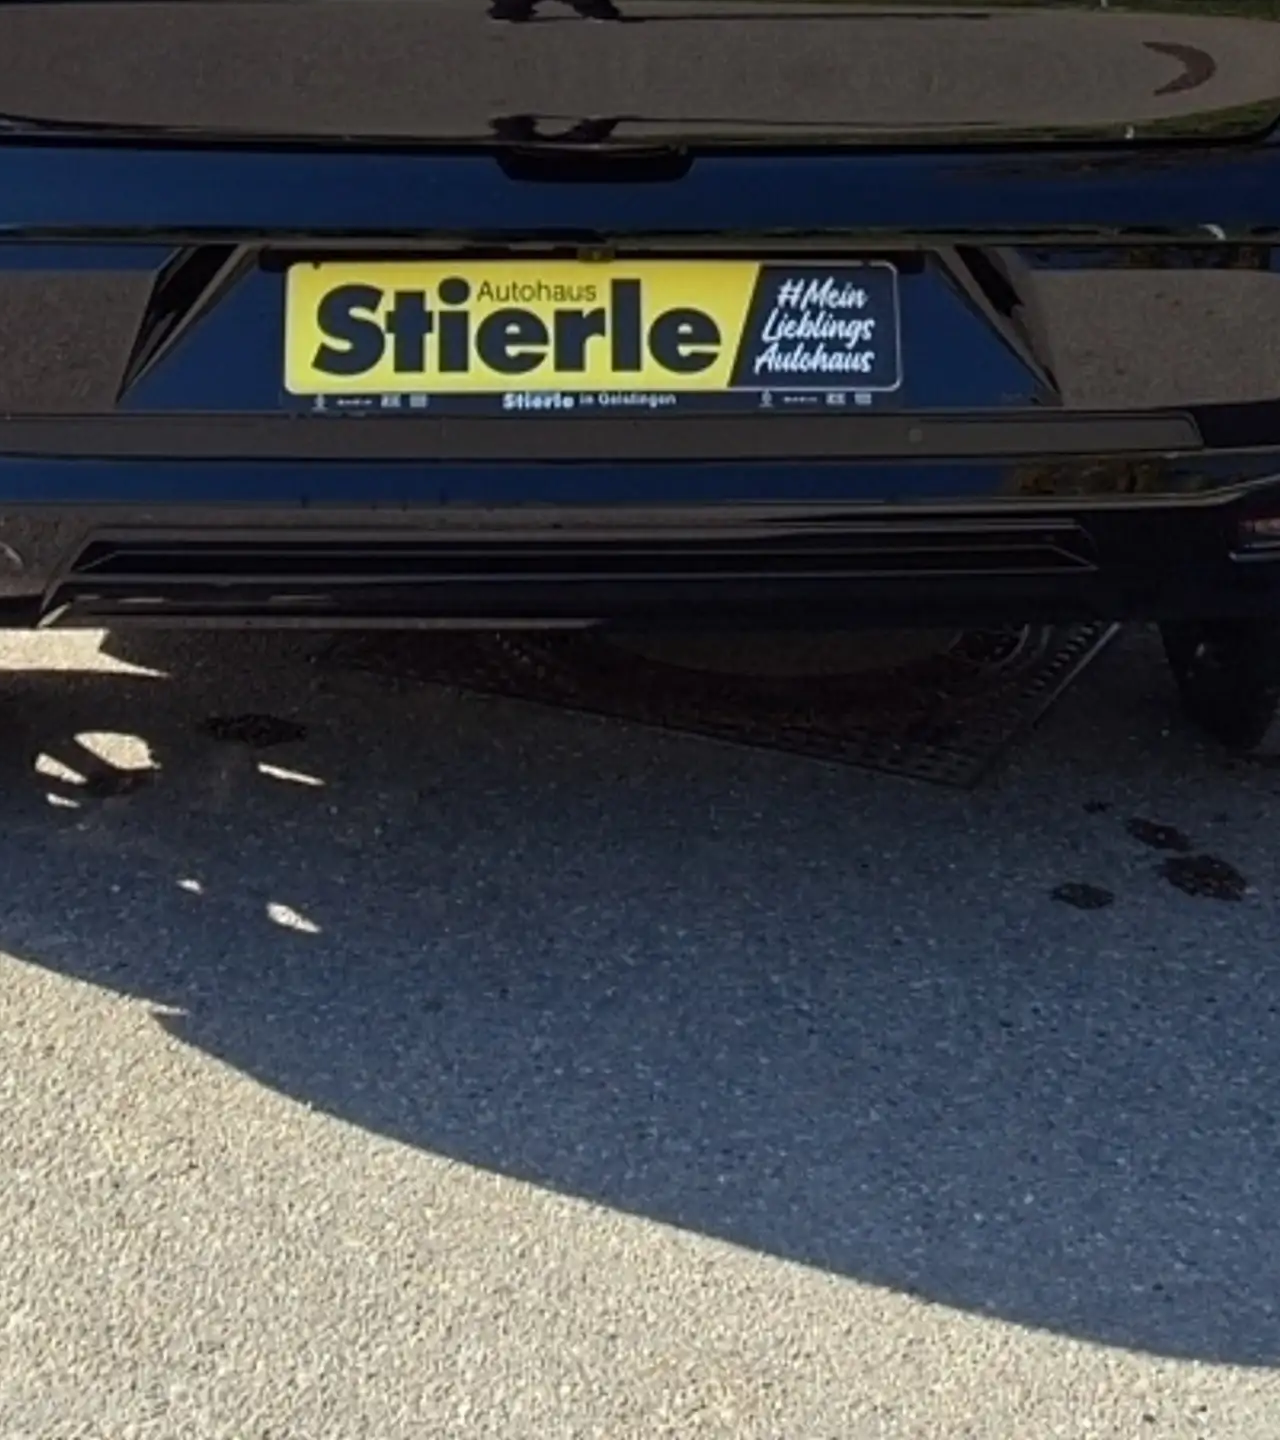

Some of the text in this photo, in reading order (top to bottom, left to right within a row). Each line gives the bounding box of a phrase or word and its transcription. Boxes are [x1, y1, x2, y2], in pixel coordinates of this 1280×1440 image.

[477, 280, 597, 304] Autohaus
[776, 276, 869, 311] #Mein
[311, 277, 721, 377] Stierle
[761, 308, 875, 350] Lieblings
[754, 341, 875, 375] Autohaus
[502, 392, 575, 410] Stierle
